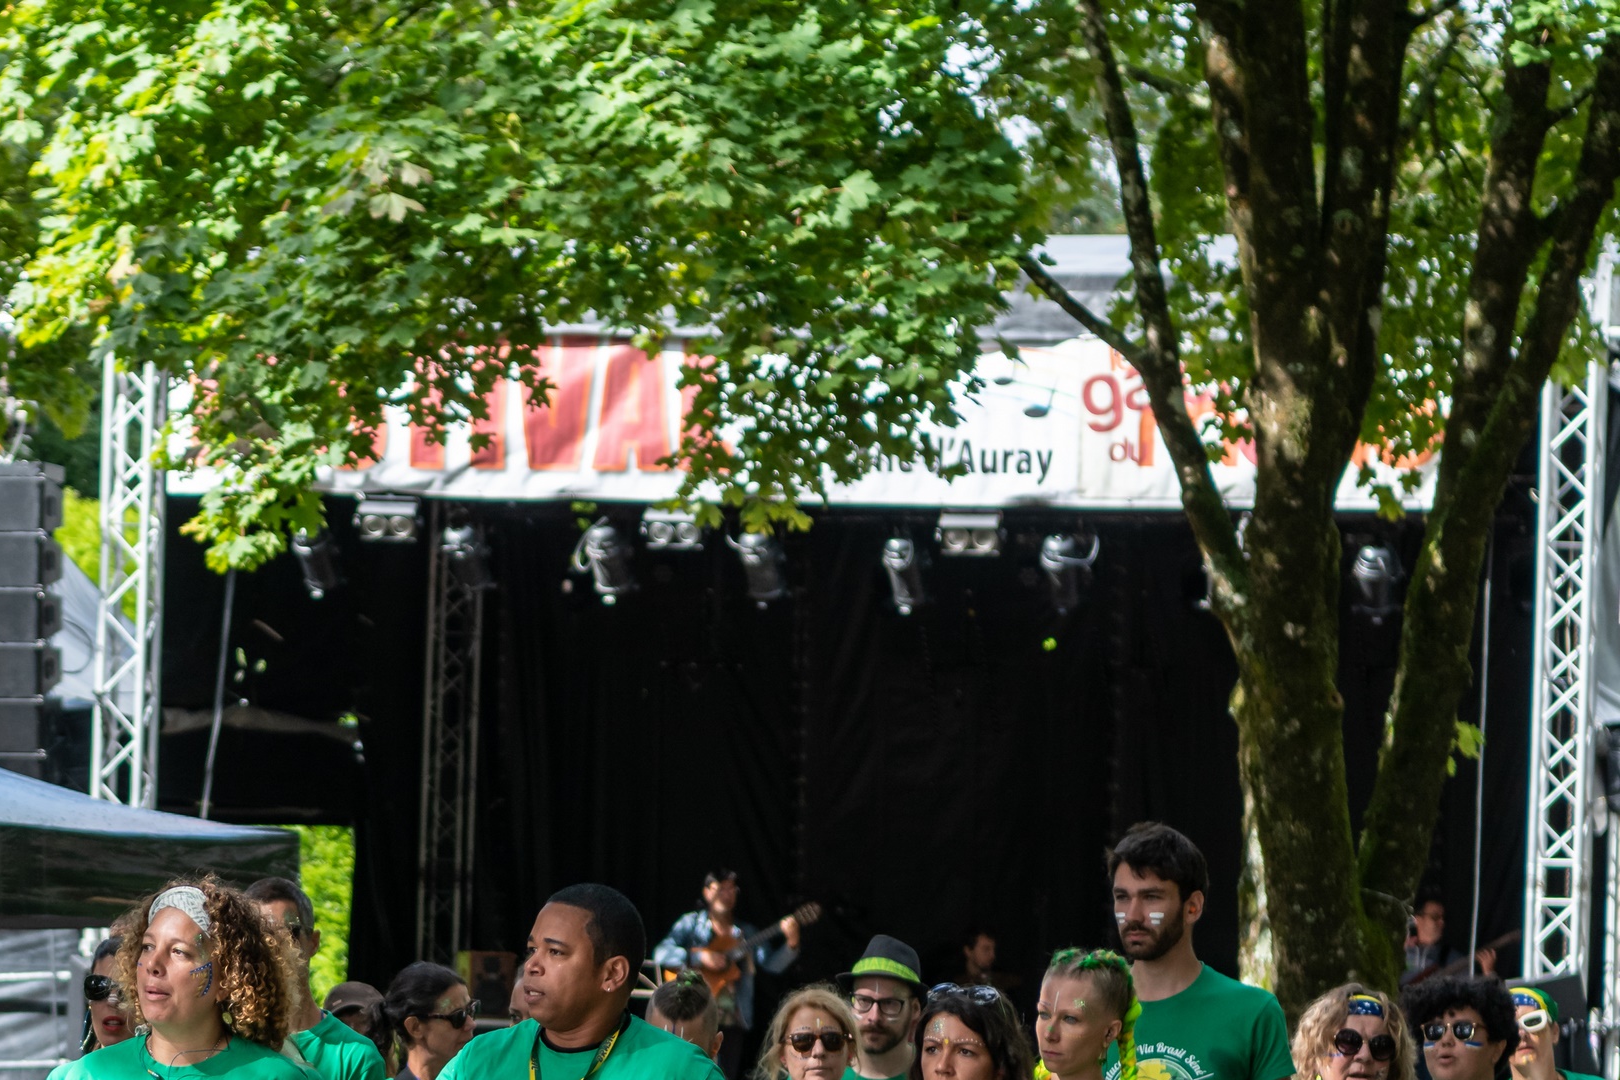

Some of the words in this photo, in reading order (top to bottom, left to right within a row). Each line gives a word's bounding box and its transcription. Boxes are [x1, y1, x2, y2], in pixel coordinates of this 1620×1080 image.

[1137, 1043, 1154, 1055] Via
[1156, 1041, 1187, 1059] Brasil
[1184, 1055, 1207, 1076] Séné
